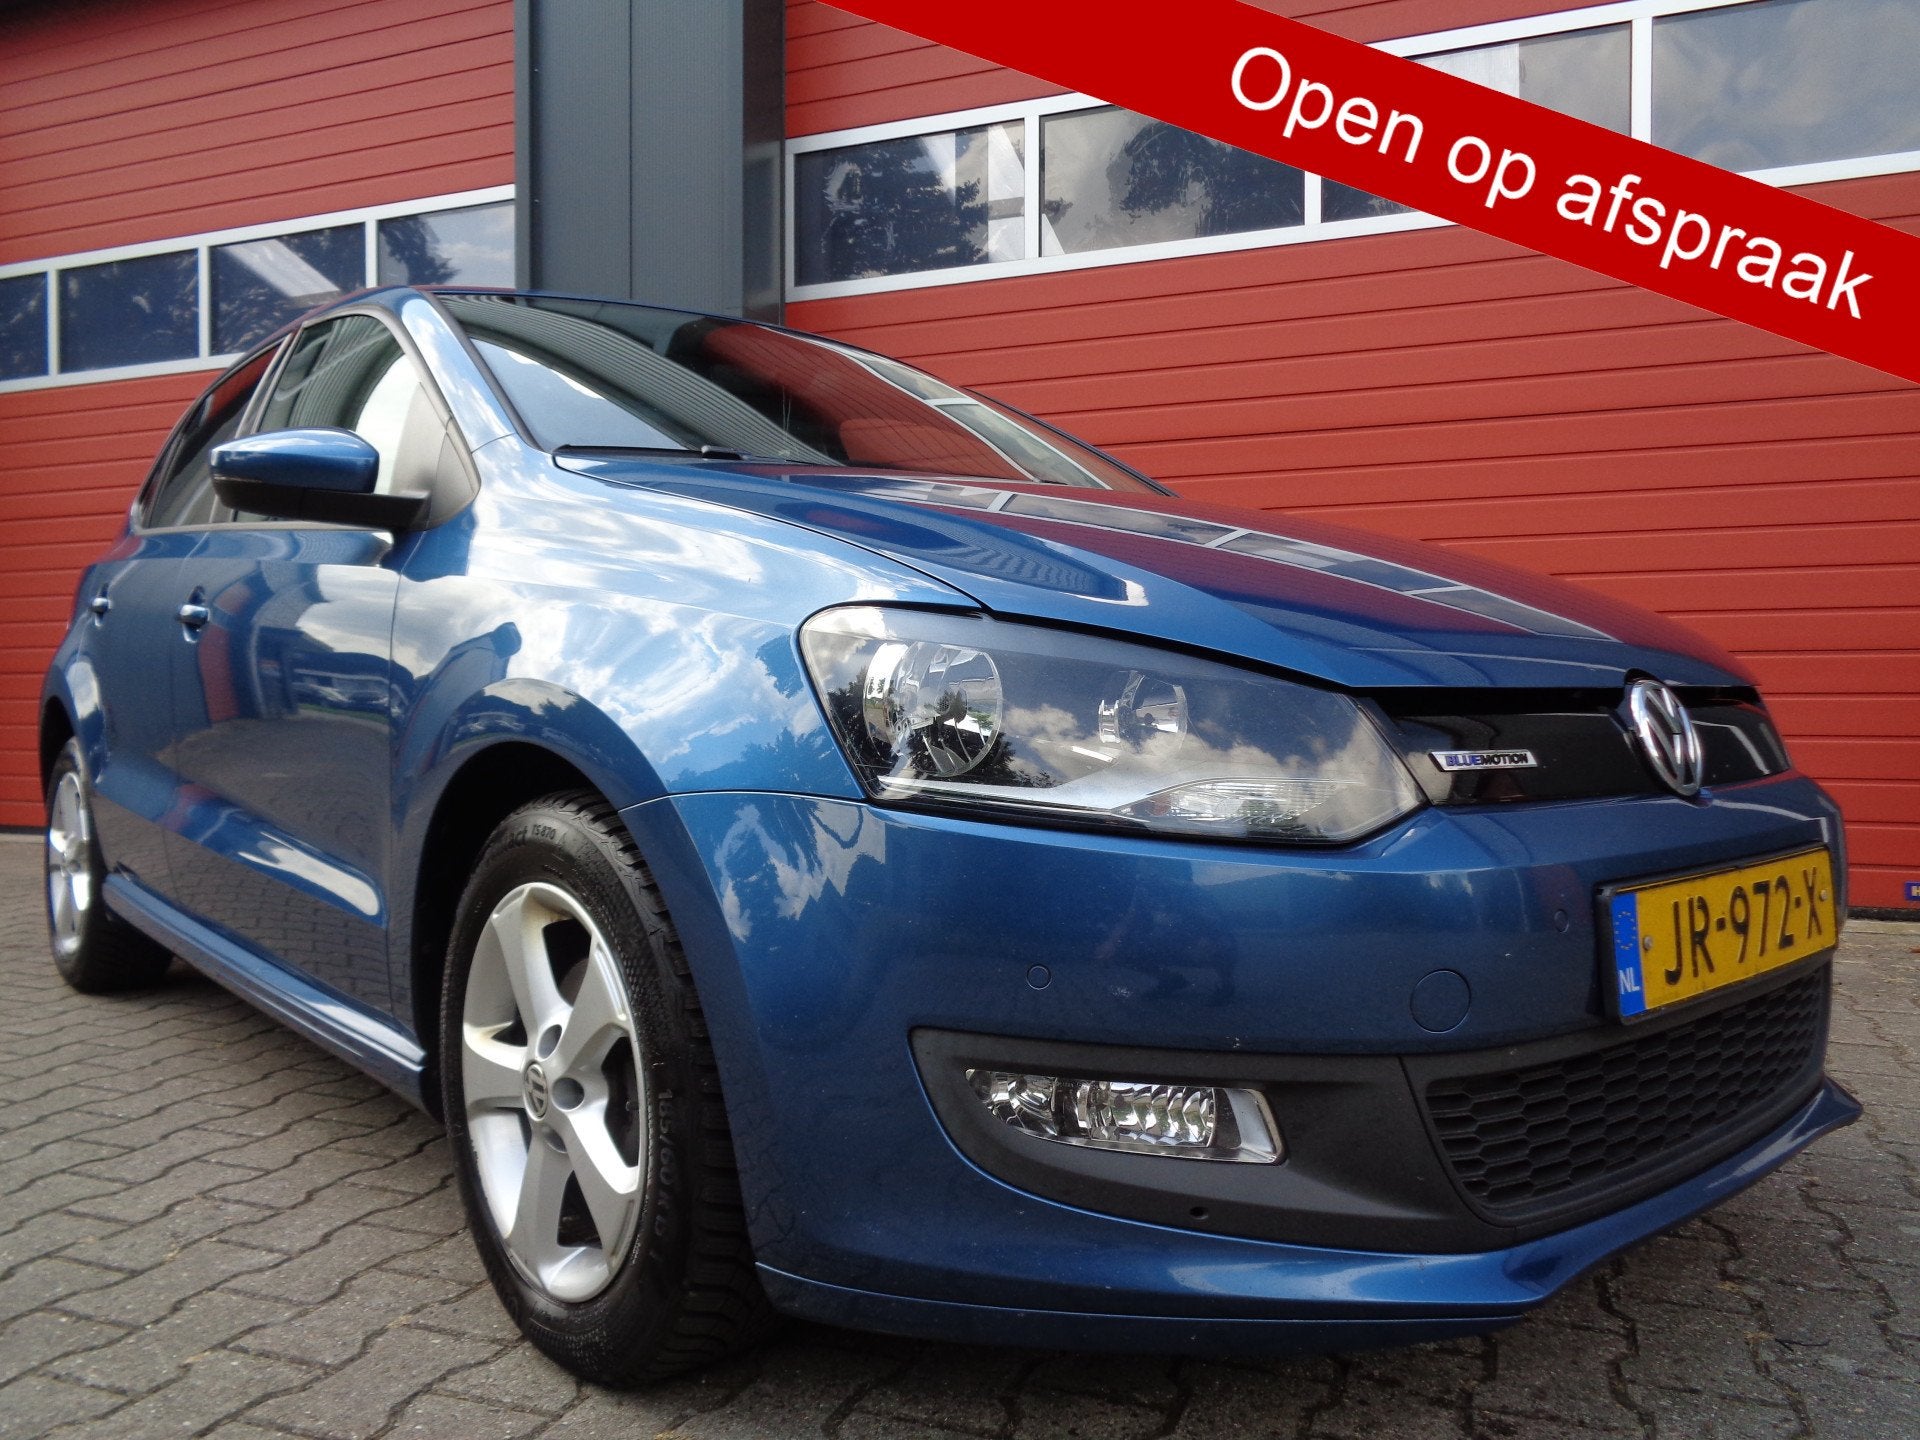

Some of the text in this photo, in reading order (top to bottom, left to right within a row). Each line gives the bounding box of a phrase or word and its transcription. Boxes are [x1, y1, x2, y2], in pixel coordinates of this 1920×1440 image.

[1444, 753, 1528, 767] BLUEMOTION
[1664, 867, 1822, 986] JR-972-X
[1618, 969, 1641, 995] NL
